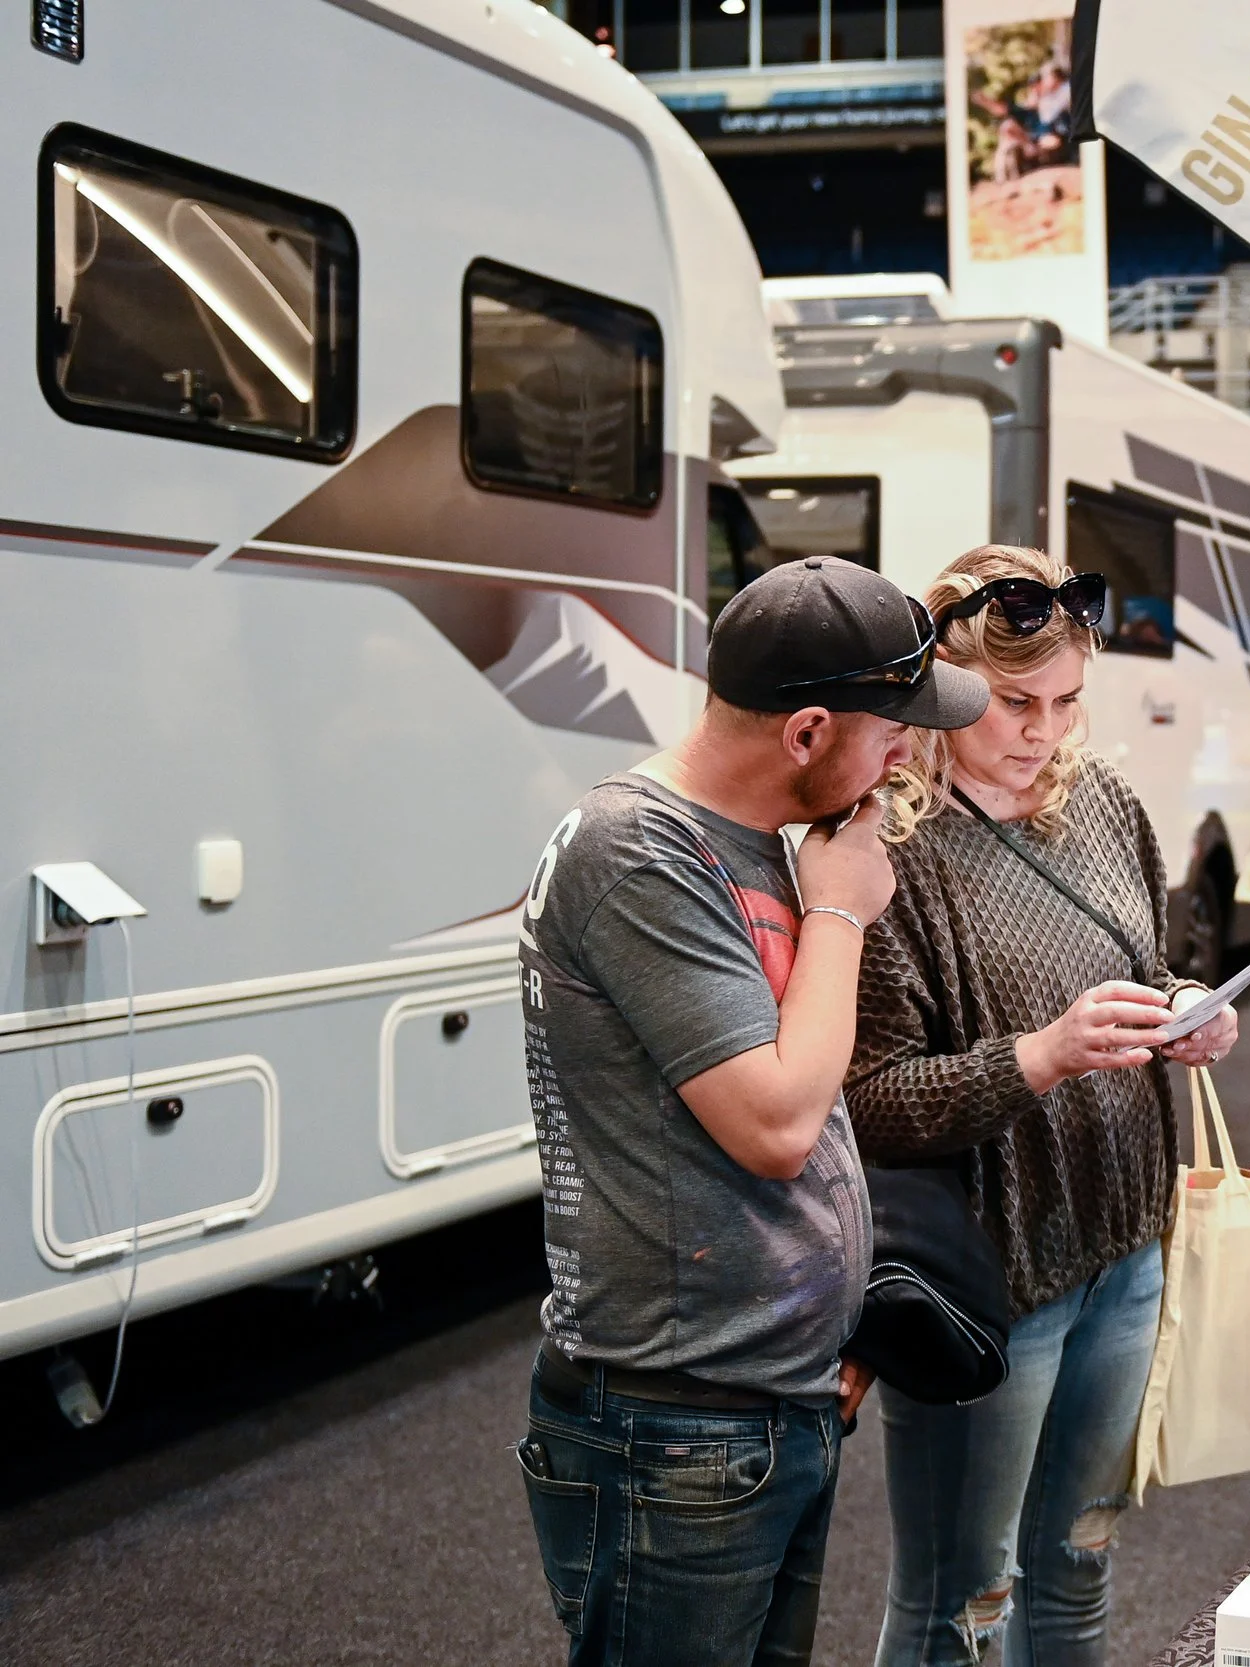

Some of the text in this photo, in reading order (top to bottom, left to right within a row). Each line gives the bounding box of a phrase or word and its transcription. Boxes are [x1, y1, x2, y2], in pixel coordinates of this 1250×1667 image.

[533, 1099, 546, 1110] SIX
[555, 1161, 576, 1173] REAR
[552, 1175, 585, 1188] CERAMIC
[560, 1191, 583, 1202] BOOST
[560, 1206, 580, 1217] BOOST
[557, 1275, 571, 1287] 276
[571, 1277, 581, 1289] HP
